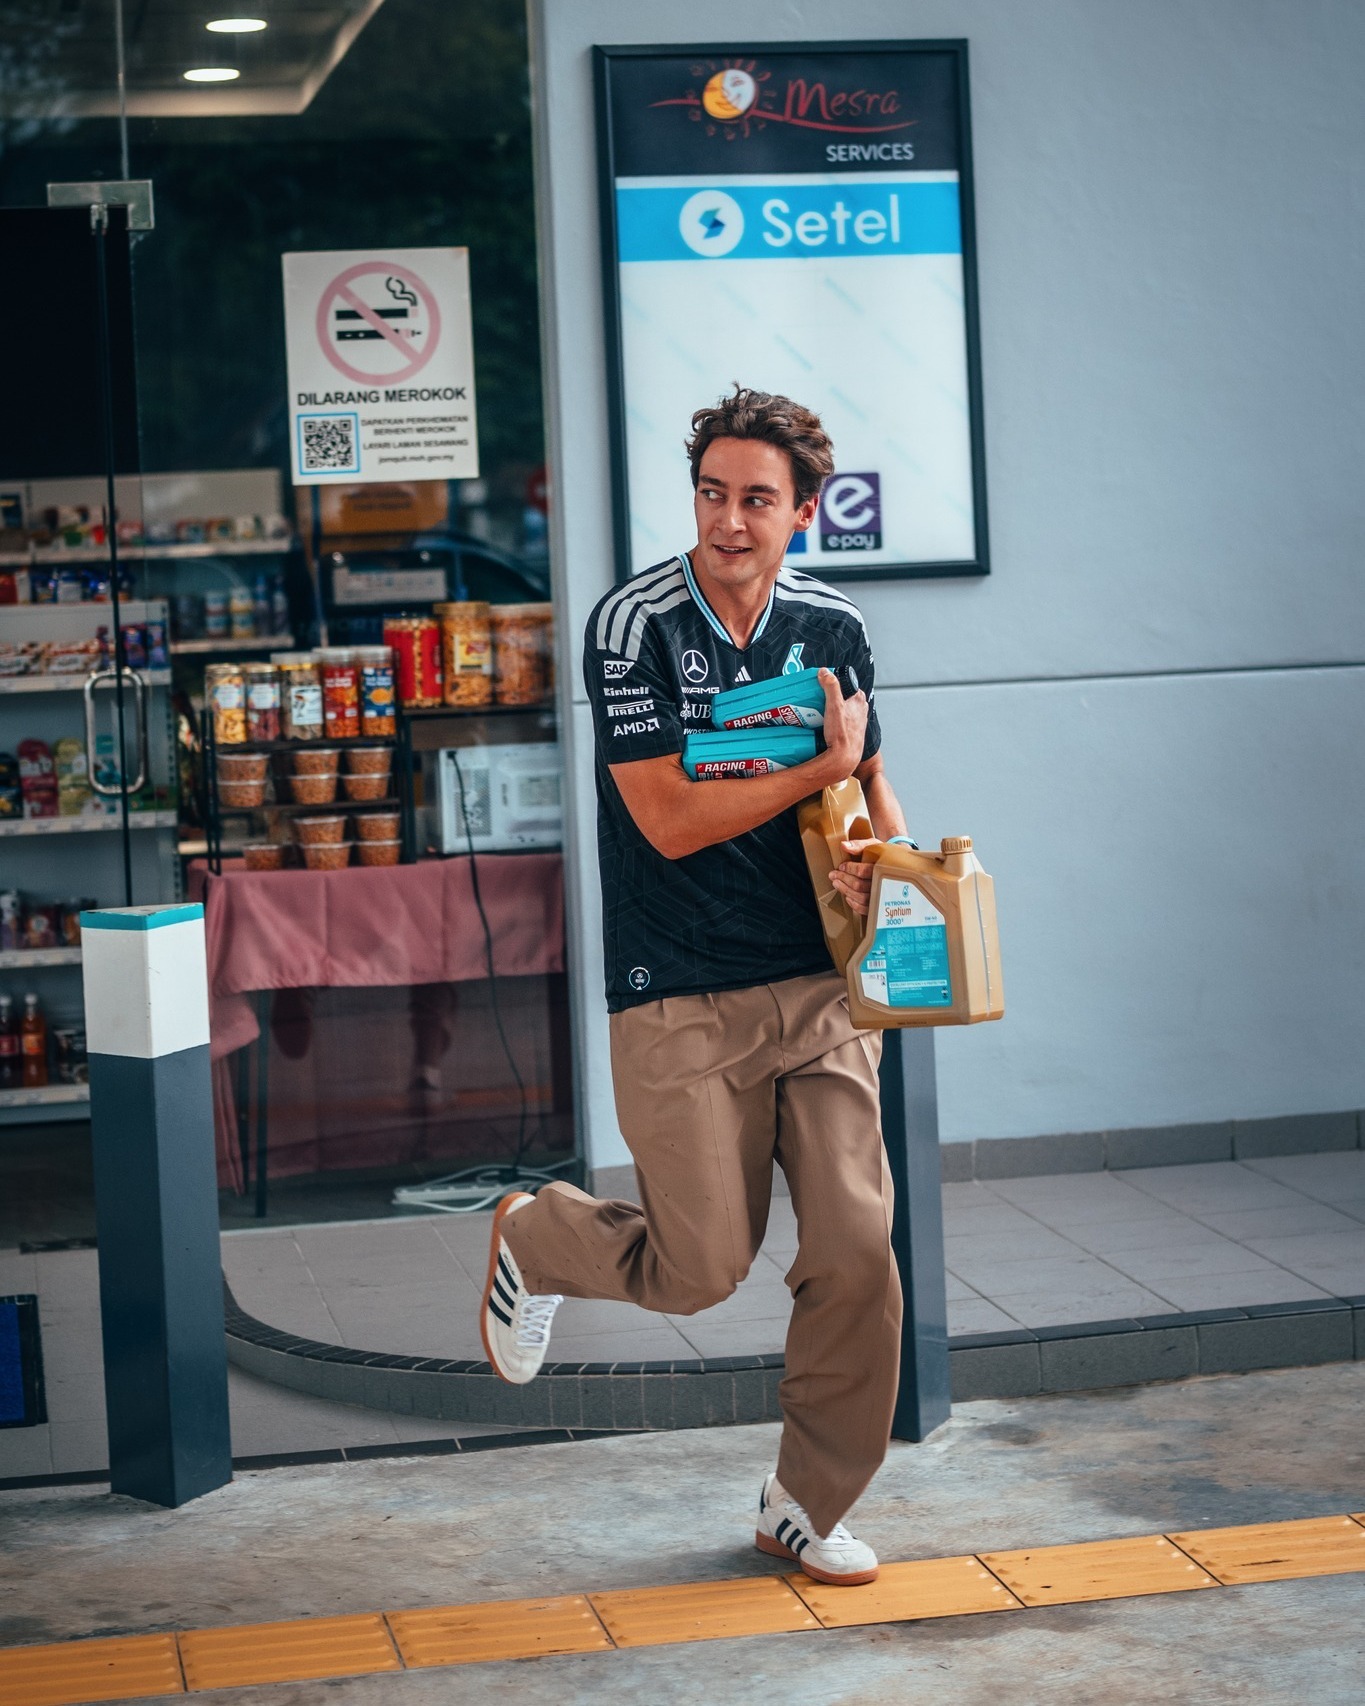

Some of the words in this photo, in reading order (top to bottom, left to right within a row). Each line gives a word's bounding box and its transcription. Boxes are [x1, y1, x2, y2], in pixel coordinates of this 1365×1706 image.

[783, 78, 901, 122] Mesra
[826, 142, 914, 162] SERVICES
[762, 193, 900, 247] Setel
[297, 390, 380, 406] DILARANG
[384, 387, 467, 403] MEROKOK
[361, 418, 404, 427] DAPATKAN
[374, 427, 413, 436] BERHENTI
[416, 425, 456, 434] MEROKOK
[363, 442, 391, 450] LAYARI
[393, 441, 421, 449] LAMAN
[605, 663, 628, 676] SAP
[603, 686, 650, 697] Einhell
[690, 686, 720, 694] AMG
[607, 699, 655, 717] PIRELLI
[691, 703, 712, 719] UB
[733, 711, 773, 728] RACING
[613, 721, 647, 737] AMD
[704, 761, 746, 773] RACING
[885, 907, 912, 919] Syntium
